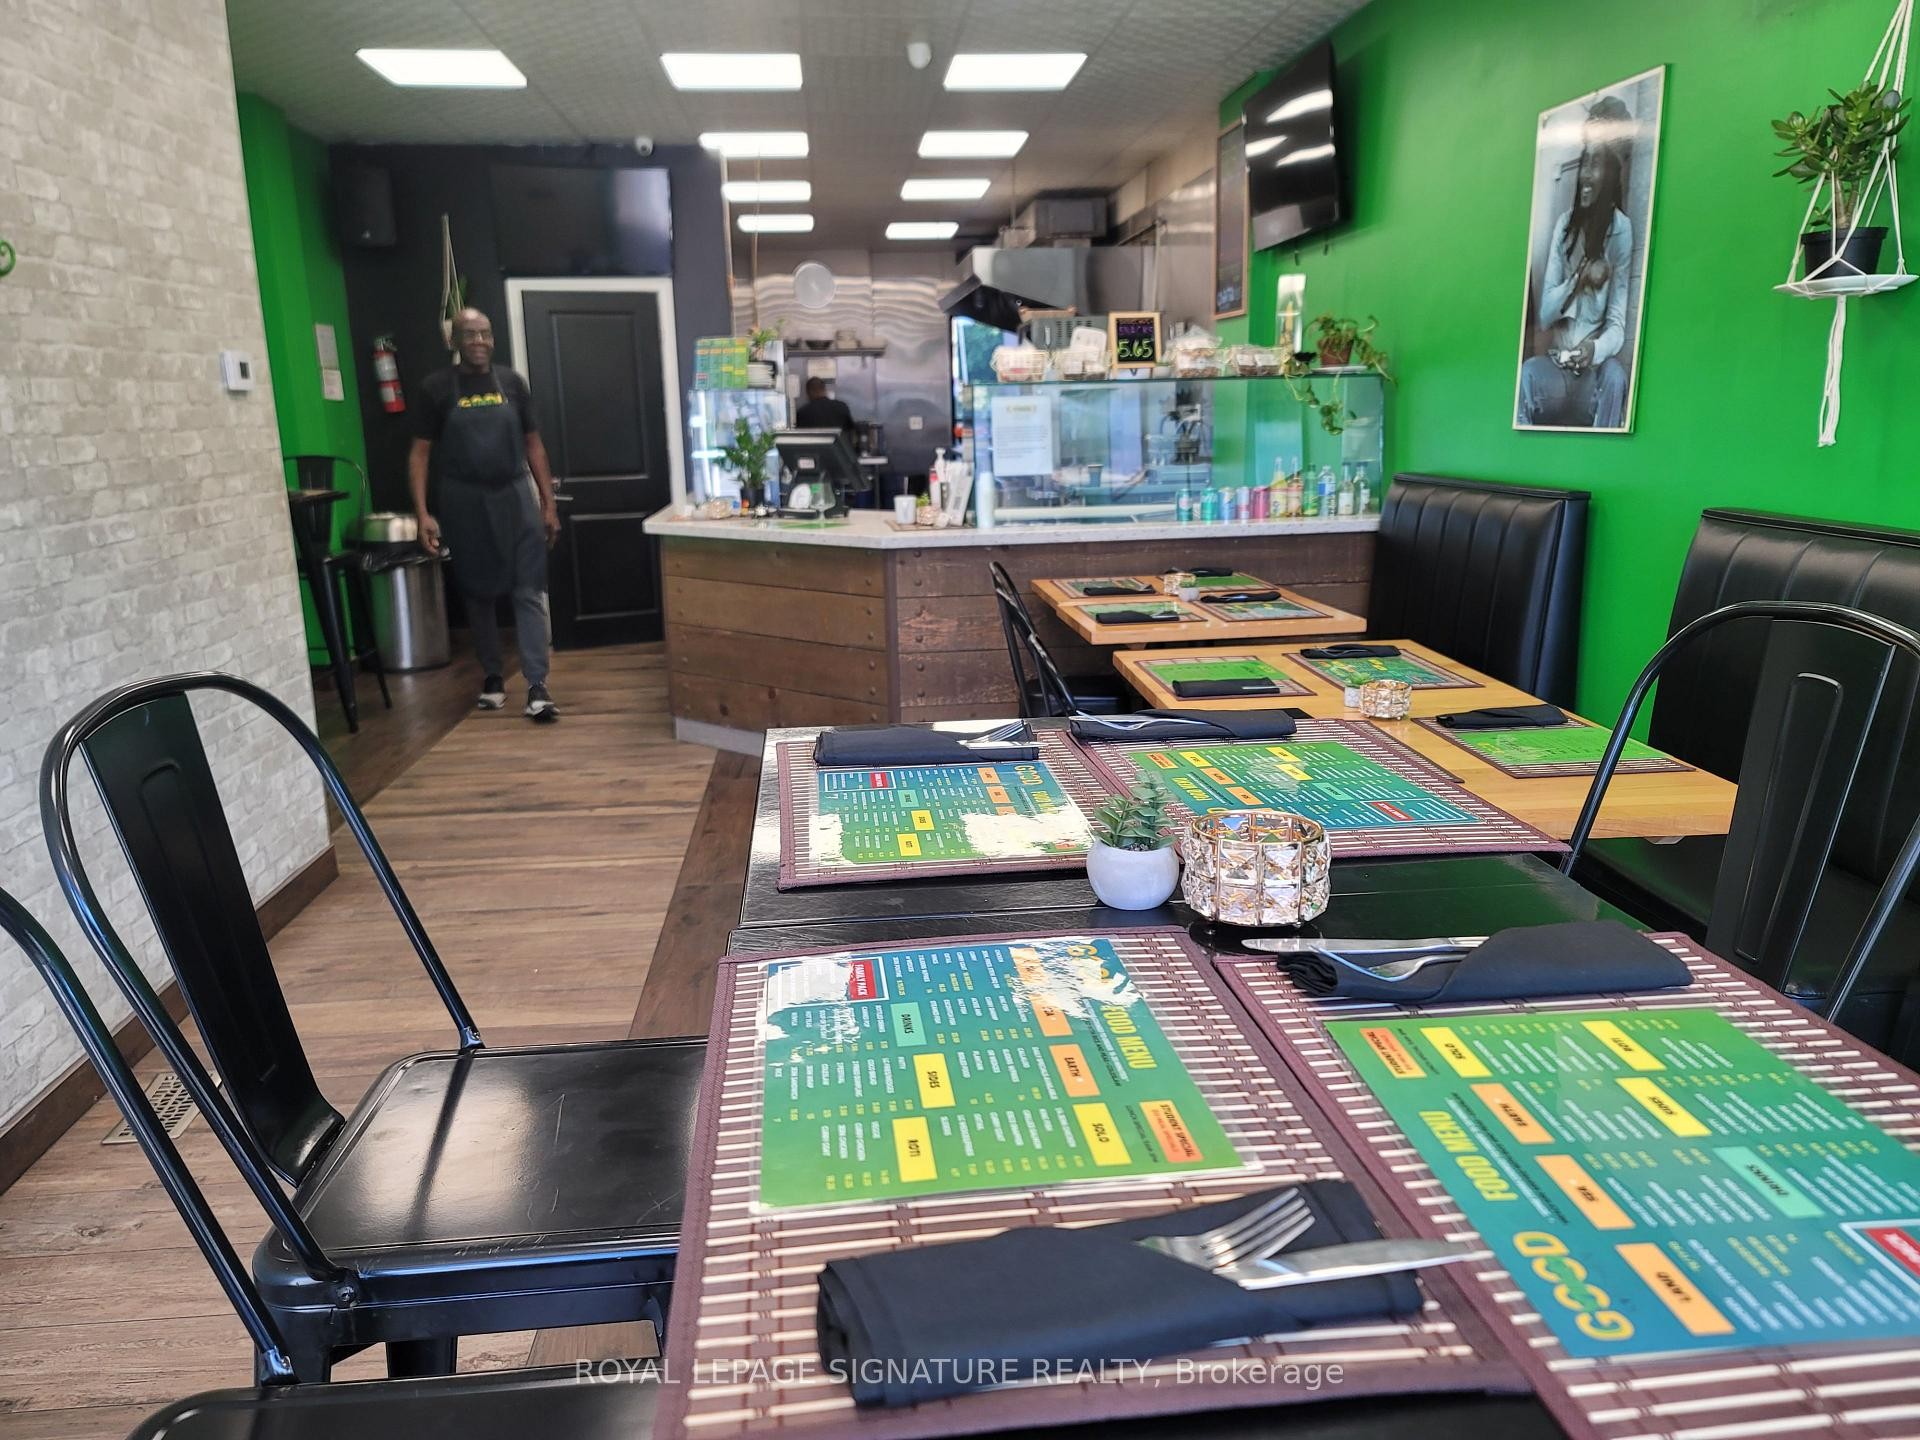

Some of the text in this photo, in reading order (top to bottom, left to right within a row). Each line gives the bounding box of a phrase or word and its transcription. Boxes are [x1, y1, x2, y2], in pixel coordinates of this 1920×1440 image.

[1118, 338, 1154, 358] 5.65
[854, 964, 867, 995] FAMILY PACK
[900, 1013, 913, 1033] DRINKS
[1101, 1005, 1137, 1034] FOOD
[1114, 1035, 1158, 1069] MENU
[1443, 1043, 1467, 1059] SOLO
[1609, 1037, 1635, 1051] ROTI
[1064, 1057, 1081, 1077] EARTH
[926, 1070, 940, 1088] SIDES
[1645, 1096, 1678, 1115] SIDES
[1091, 1122, 1110, 1143] SOLO
[1418, 1109, 1480, 1153] MENU
[906, 1138, 921, 1157] ROTI
[1455, 1155, 1519, 1201] FOOD
[1743, 1164, 1792, 1195] DRINKS
[1511, 1230, 1636, 1341] GOOD
[1656, 1271, 1694, 1302] LAND
